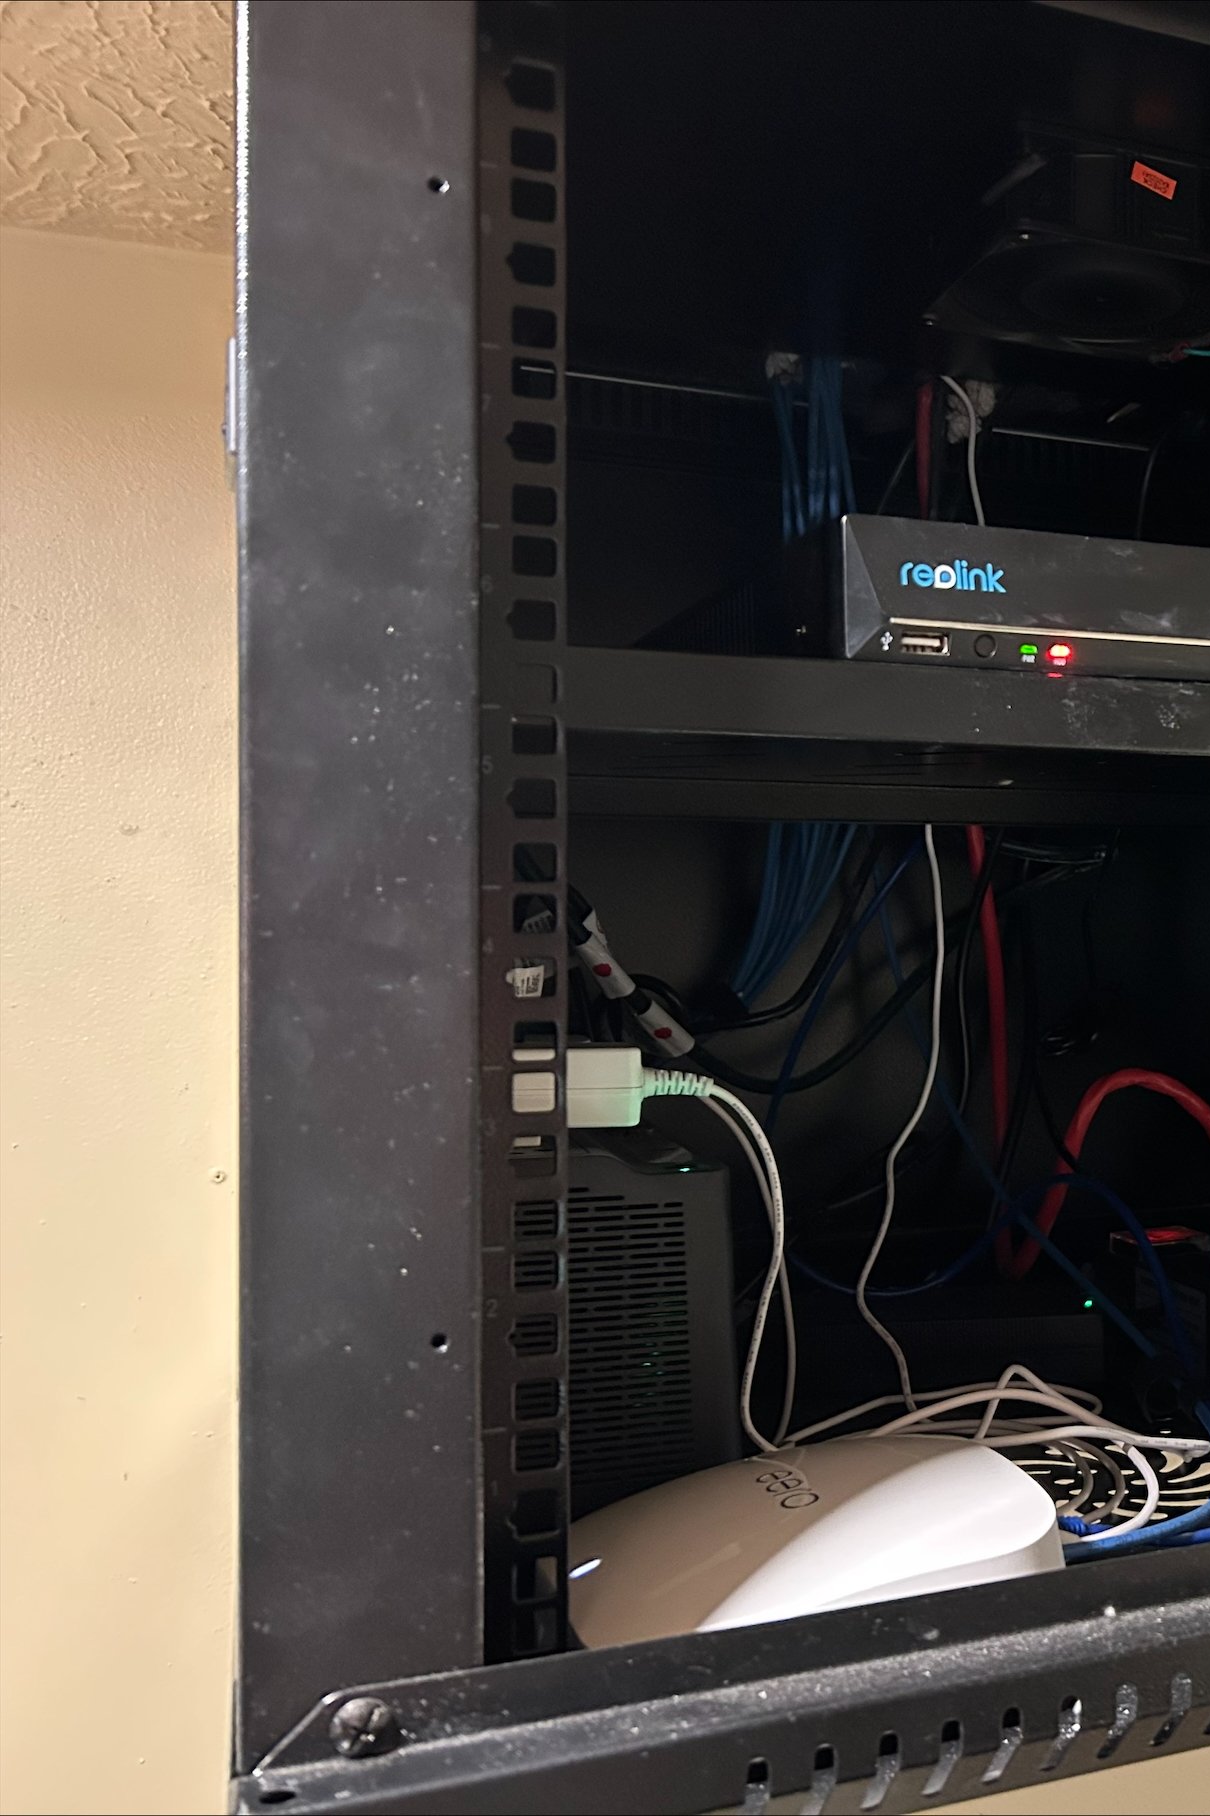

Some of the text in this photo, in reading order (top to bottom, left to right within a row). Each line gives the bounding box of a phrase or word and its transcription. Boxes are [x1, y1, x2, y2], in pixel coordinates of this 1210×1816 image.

[899, 559, 1007, 594] reolink
[482, 756, 493, 774] 5
[486, 1300, 498, 1317] 2
[755, 1469, 820, 1510] eero
